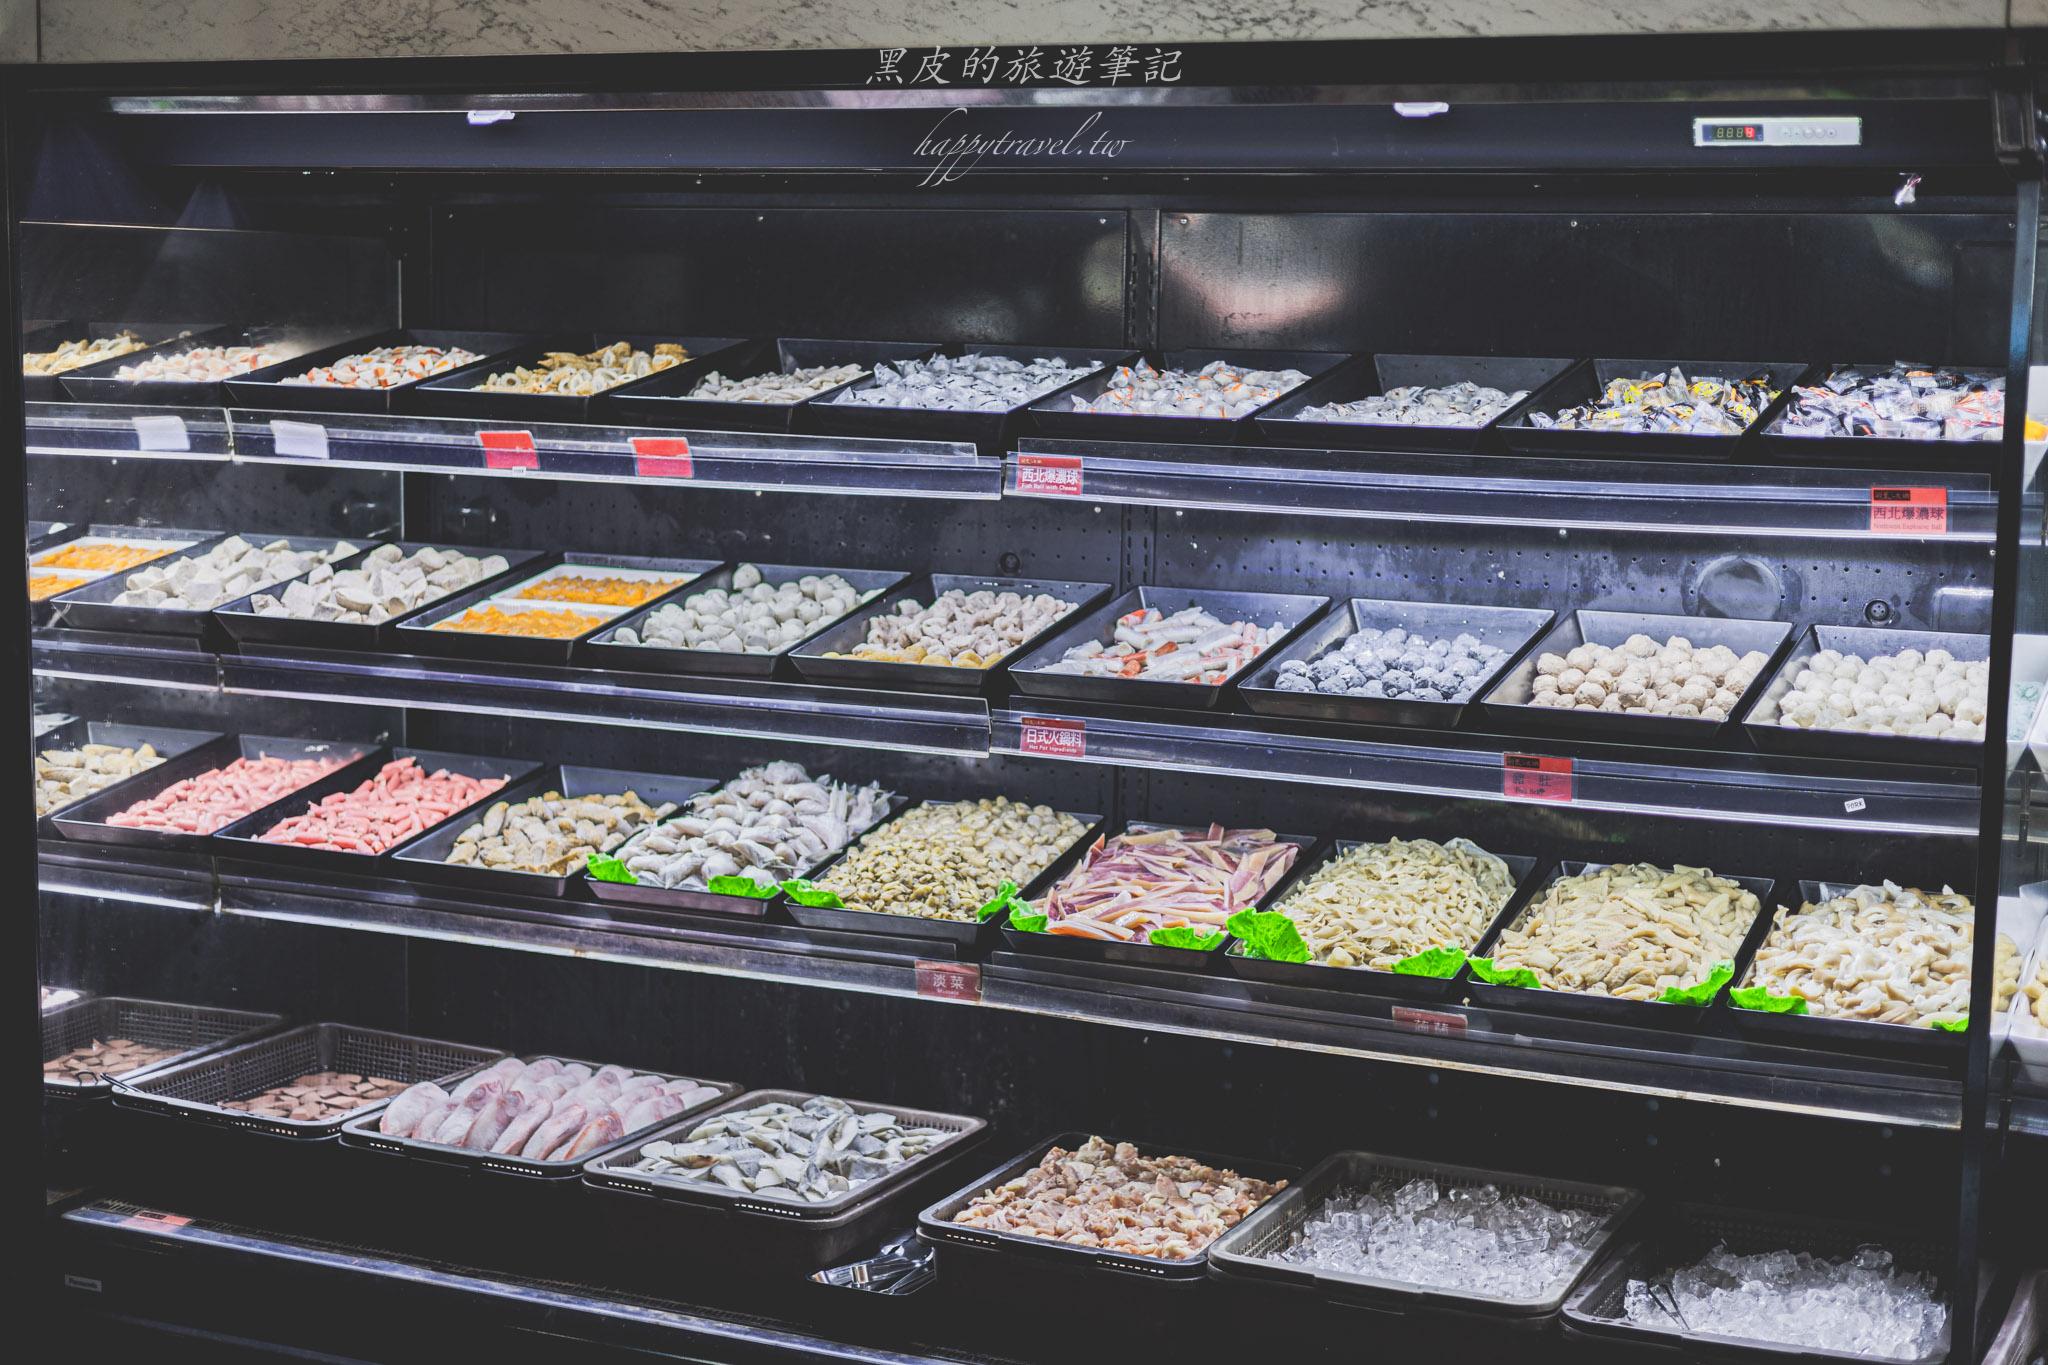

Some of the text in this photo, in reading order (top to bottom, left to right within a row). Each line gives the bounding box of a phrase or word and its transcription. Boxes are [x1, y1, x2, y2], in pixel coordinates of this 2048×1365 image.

[1022, 468, 1078, 484] 西北爆濃球
[1873, 507, 1944, 520] 西北爆濃球
[1027, 728, 1082, 747] 日式火鍋料
